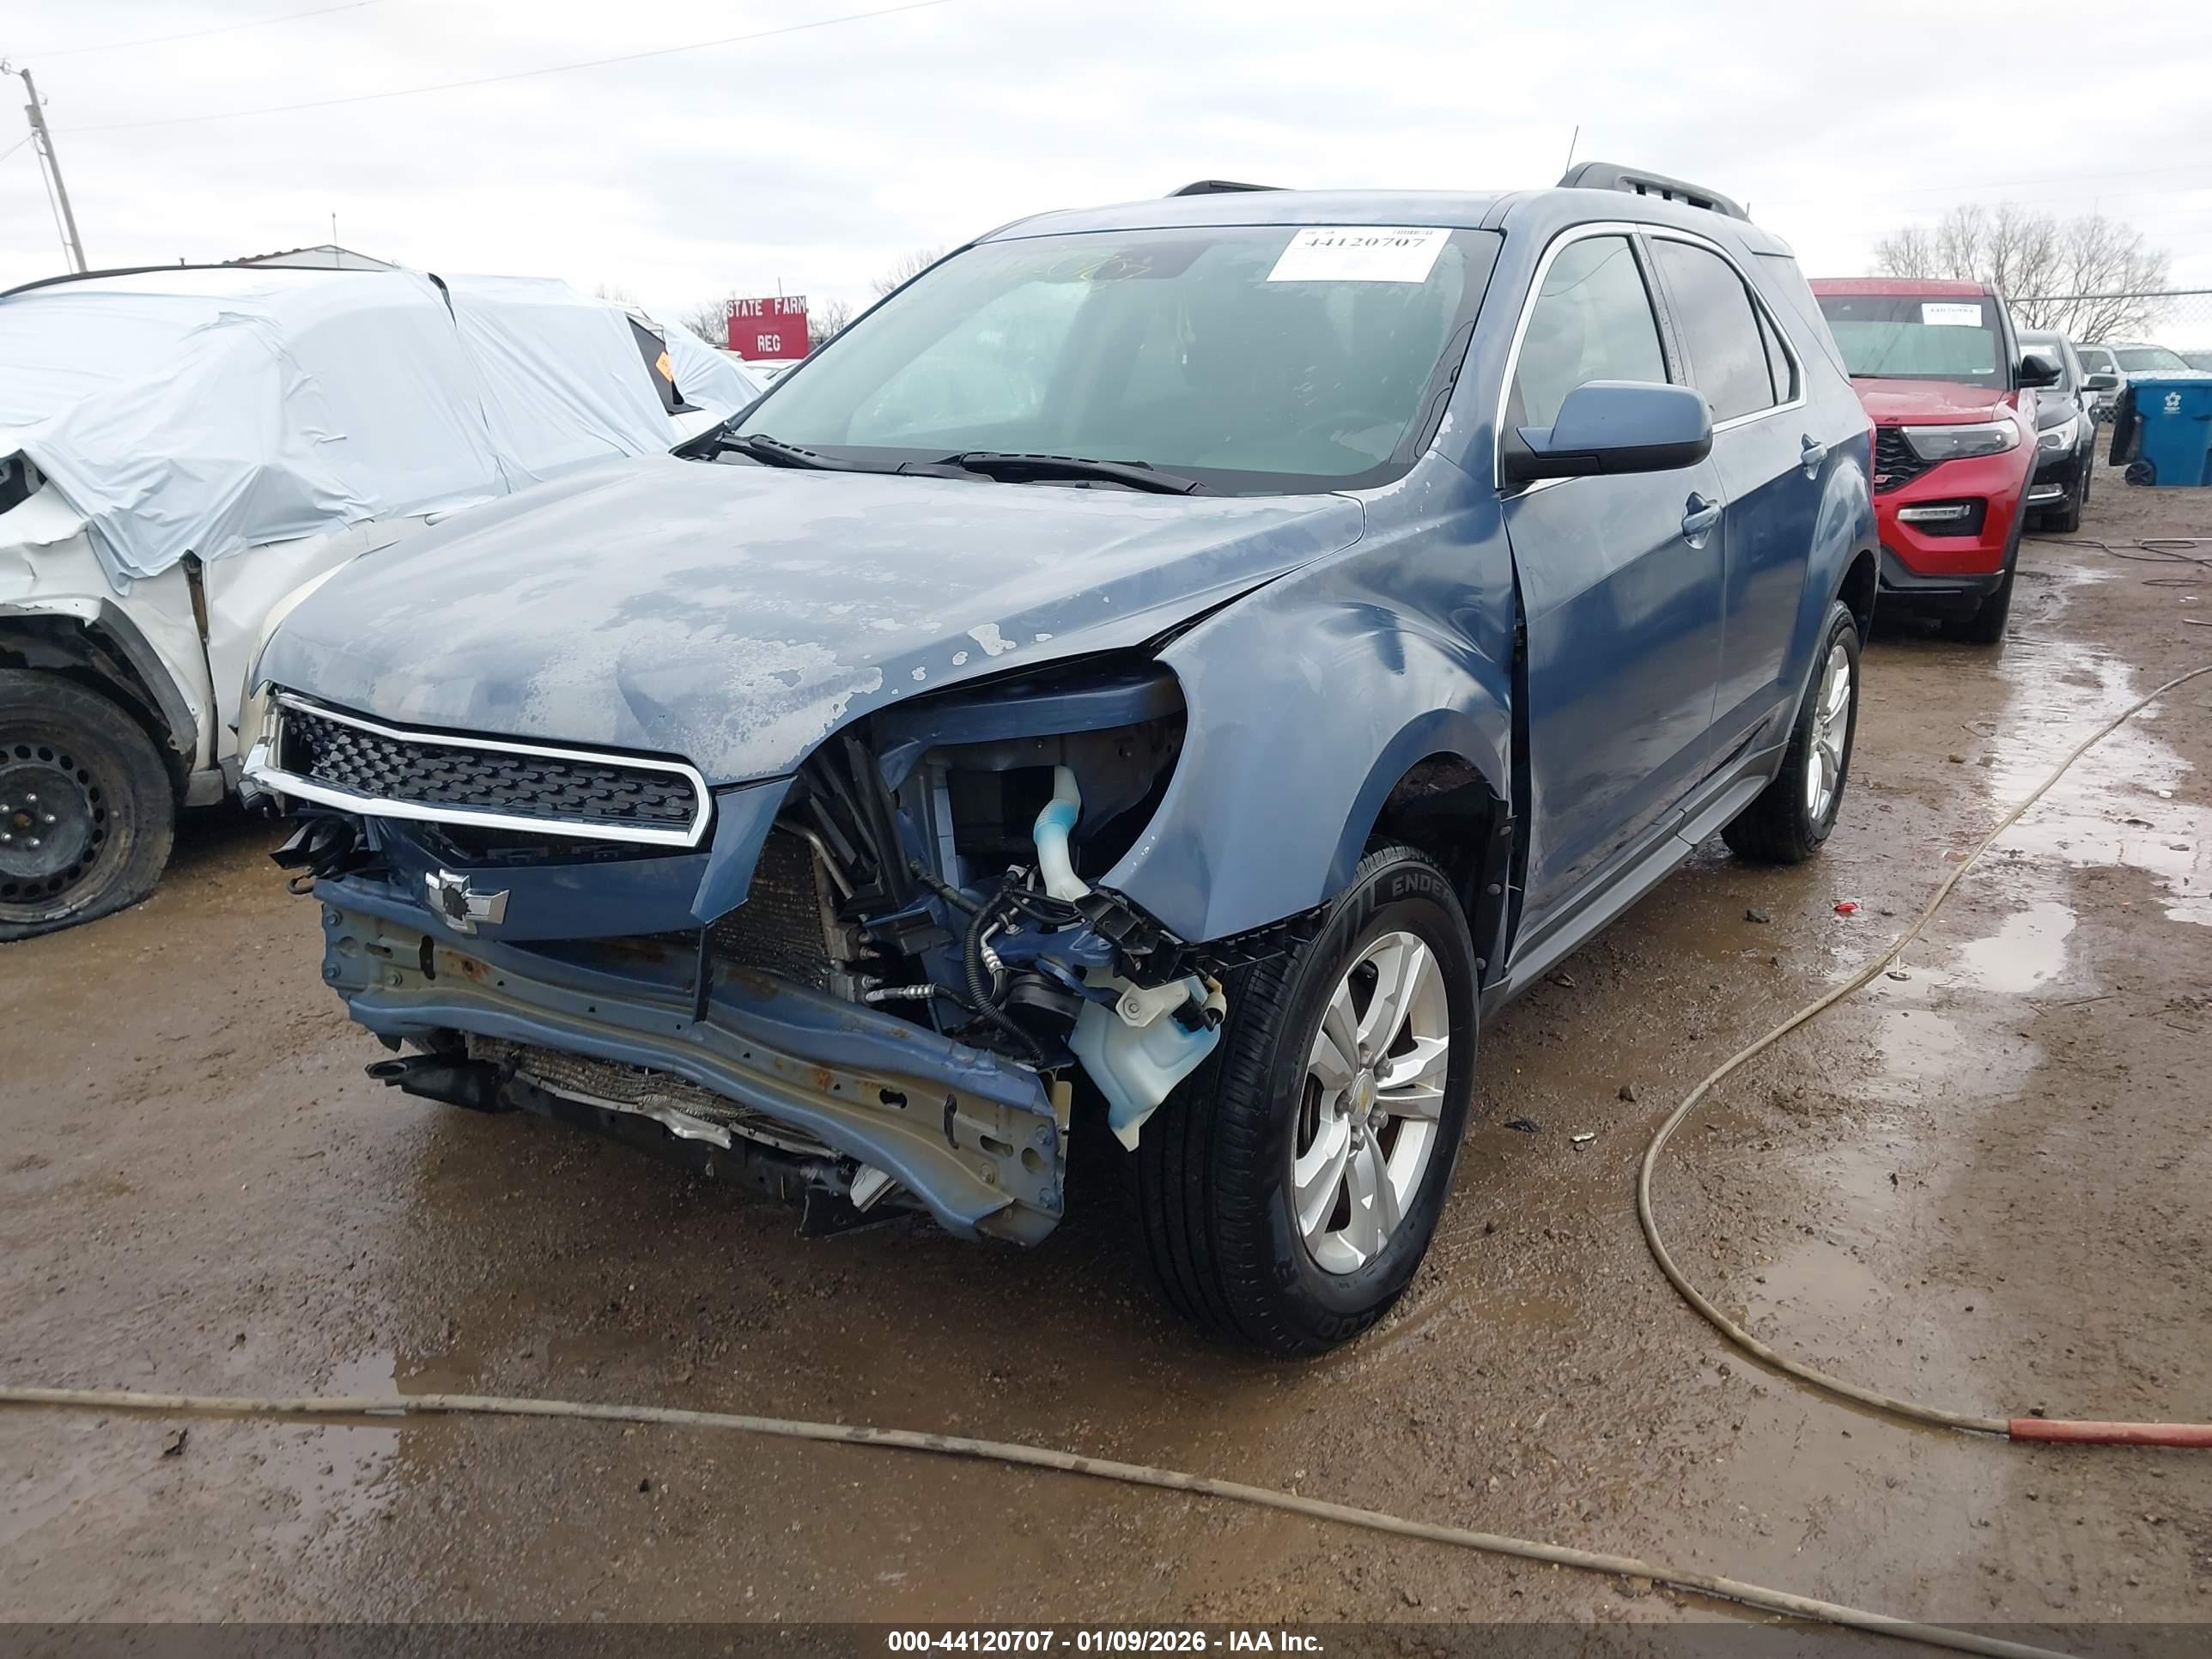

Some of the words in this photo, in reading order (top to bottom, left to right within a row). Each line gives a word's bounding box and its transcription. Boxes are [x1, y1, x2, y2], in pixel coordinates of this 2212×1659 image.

[1305, 237, 1426, 247] 44120707
[727, 299, 763, 318] STATE
[774, 296, 806, 315] FARM
[757, 334, 781, 352] REG
